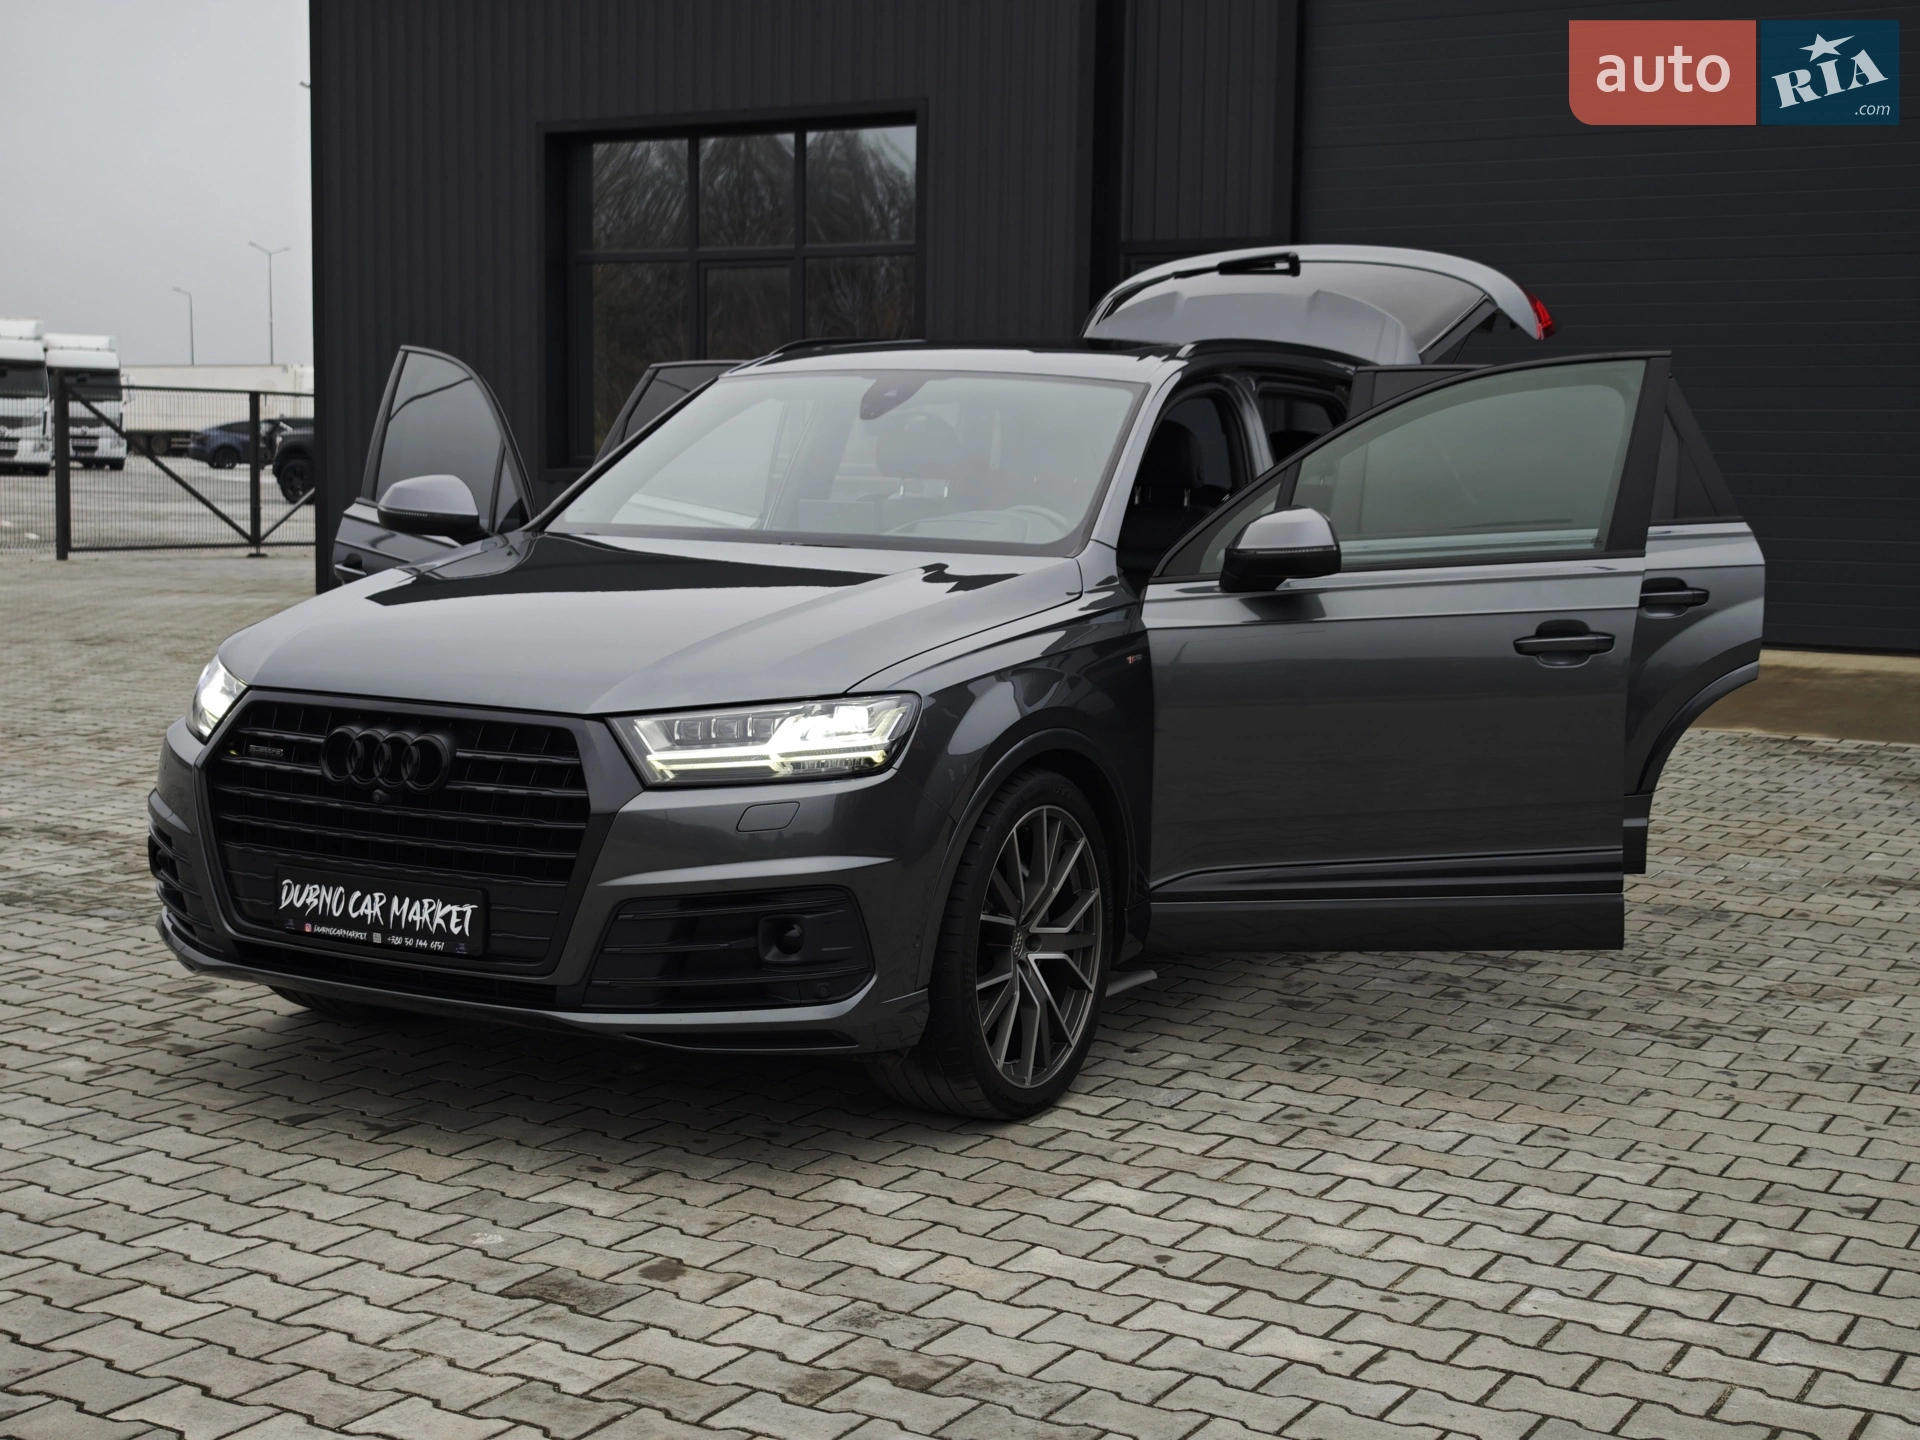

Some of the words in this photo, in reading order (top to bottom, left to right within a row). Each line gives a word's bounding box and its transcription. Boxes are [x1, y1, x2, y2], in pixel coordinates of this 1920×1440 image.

[279, 879, 346, 917] DUBNO
[348, 890, 387, 926] CAR
[390, 895, 478, 937] MARKET
[387, 936, 403, 946] +380
[404, 938, 414, 947] 50
